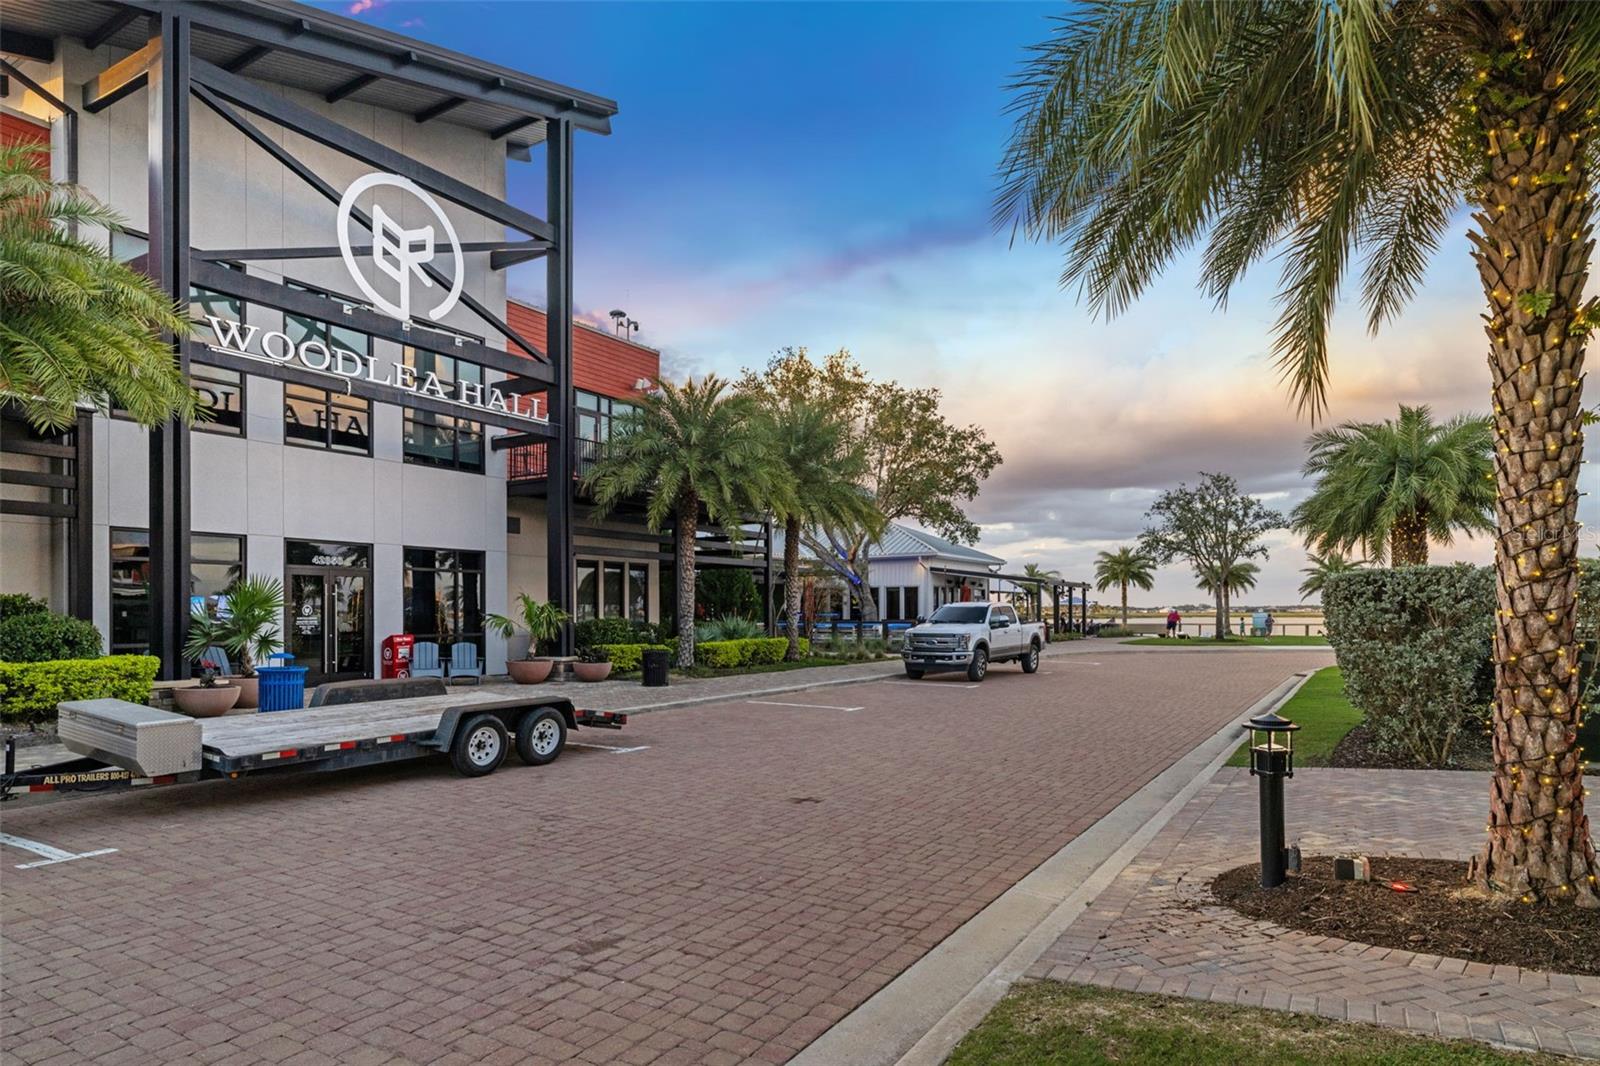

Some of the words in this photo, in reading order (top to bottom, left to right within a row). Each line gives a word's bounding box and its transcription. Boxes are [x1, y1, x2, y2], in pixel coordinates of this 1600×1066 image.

[204, 314, 447, 399] WOODLEA
[457, 379, 550, 422] HALL
[43, 776, 60, 785] ALL
[60, 775, 77, 784] PRO
[77, 772, 109, 782] TRAILERS
